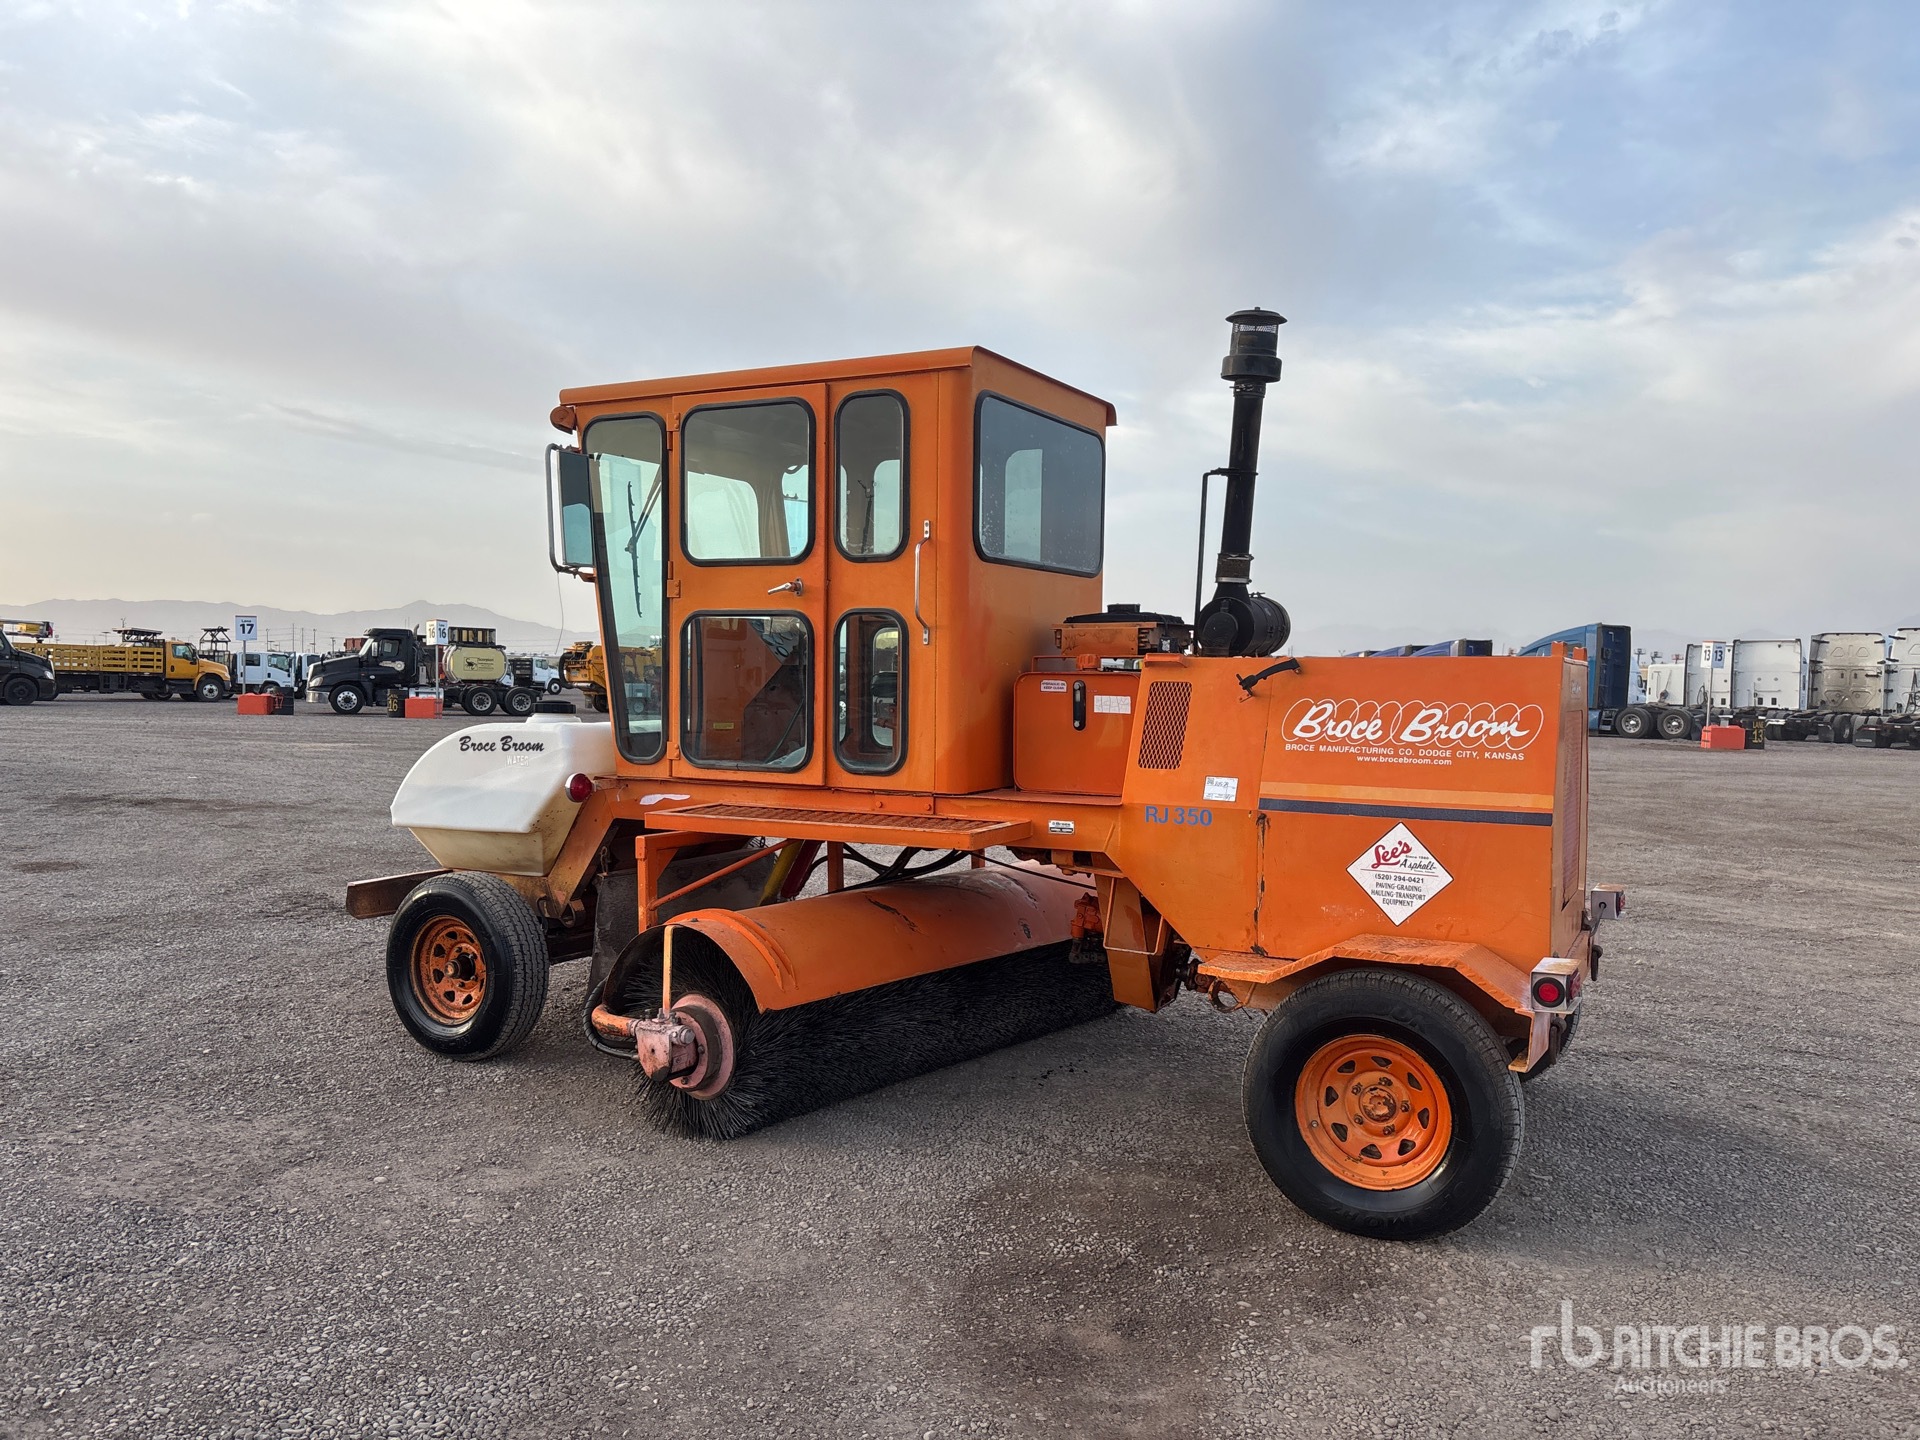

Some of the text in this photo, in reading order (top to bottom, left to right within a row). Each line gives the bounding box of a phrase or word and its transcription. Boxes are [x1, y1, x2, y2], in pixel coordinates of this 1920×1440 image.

[240, 623, 254, 634] 17
[428, 628, 436, 639] 16
[438, 628, 447, 639] 16
[1703, 649, 1711, 661] 13
[1714, 650, 1723, 662] 13
[388, 699, 398, 712] 16
[1292, 702, 1530, 743] Broce Broom
[1752, 729, 1764, 743] 13
[459, 735, 545, 752] Broce Broom
[1285, 743, 1525, 761] BROCE MANUFACTURING CO. DODGE CITY, KANSAS
[1356, 755, 1452, 766] www.brocebroom.com
[1145, 805, 1213, 826] RJ 350
[1371, 840, 1412, 869] Lee's
[1374, 873, 1424, 884] (520) 294-0421
[1382, 897, 1414, 907] EQUIPMENT
